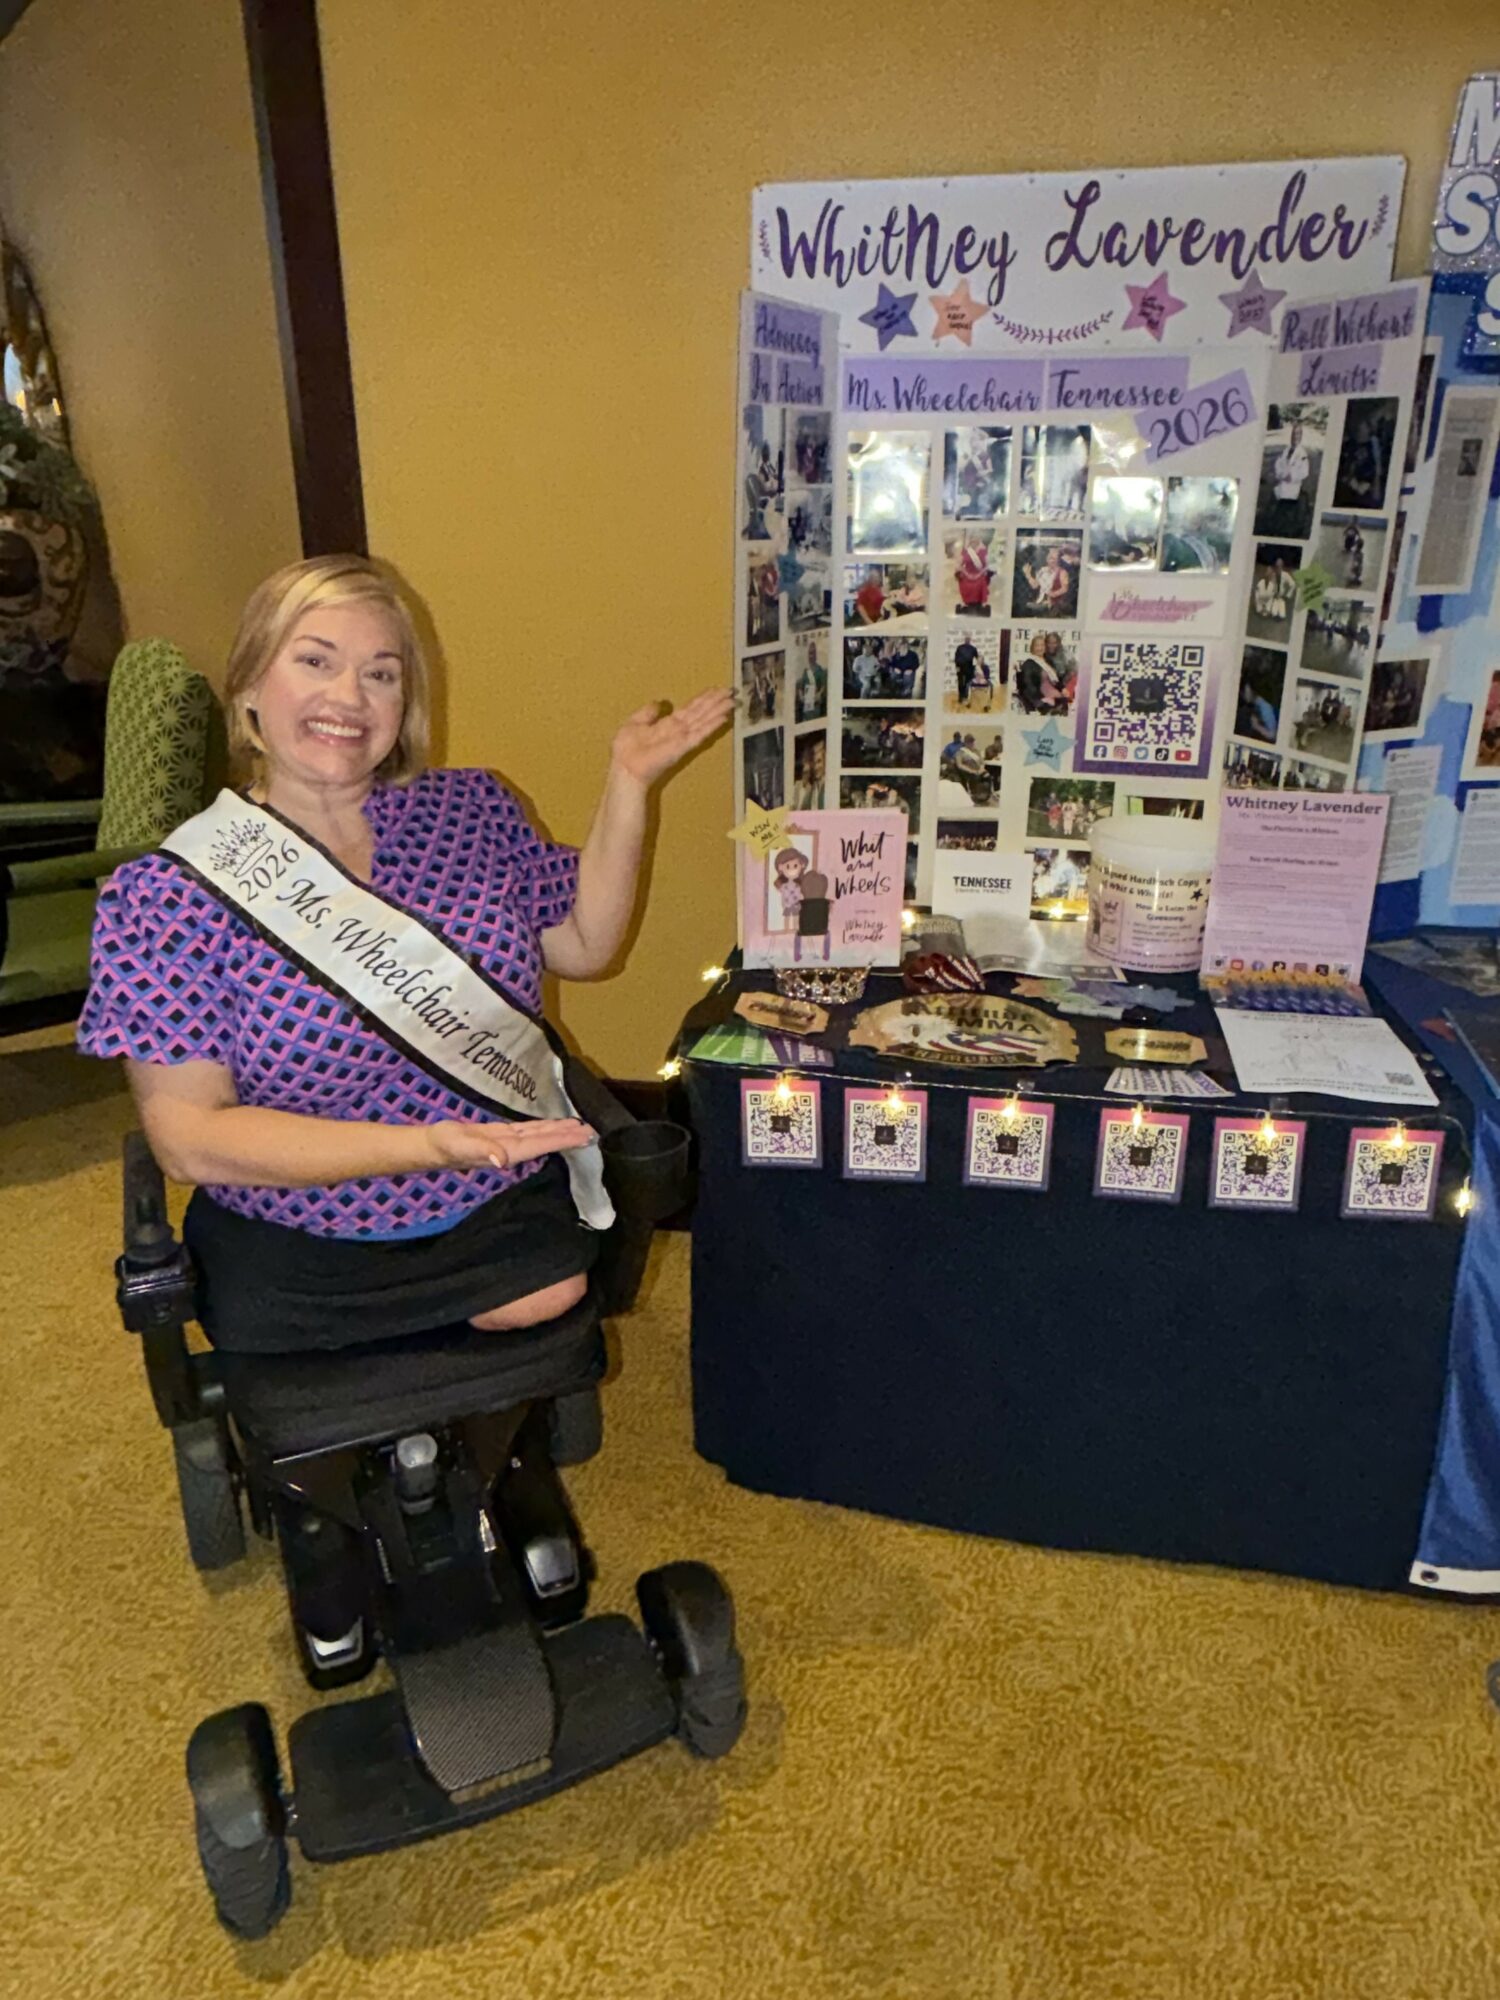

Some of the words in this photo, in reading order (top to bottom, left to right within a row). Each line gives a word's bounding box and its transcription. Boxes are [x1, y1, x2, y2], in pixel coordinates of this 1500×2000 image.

[1045, 171, 1369, 279] Lavender
[1282, 310, 1330, 352] Roll
[1335, 301, 1413, 346] Without
[751, 353, 770, 403] In
[848, 373, 886, 411] Ms.
[893, 375, 1041, 412] Wheelchair
[1049, 368, 1185, 408] Tennessee
[1149, 387, 1249, 459] 2026
[1226, 795, 1299, 815] Whitney
[1302, 798, 1384, 816] Lavender
[749, 818, 771, 838] WIN
[840, 831, 895, 864] Whit
[846, 857, 874, 873] and
[1103, 865, 1128, 881] Sgned
[1177, 878, 1201, 889] Copy
[835, 872, 891, 900] Wheels
[953, 876, 1012, 890] TENNESSEE
[237, 838, 301, 903] 2026
[275, 876, 331, 930] Ms.
[331, 916, 471, 1039] Wheelchair
[459, 1029, 539, 1103] Tennessee
[956, 1017, 1043, 1035] MMA
